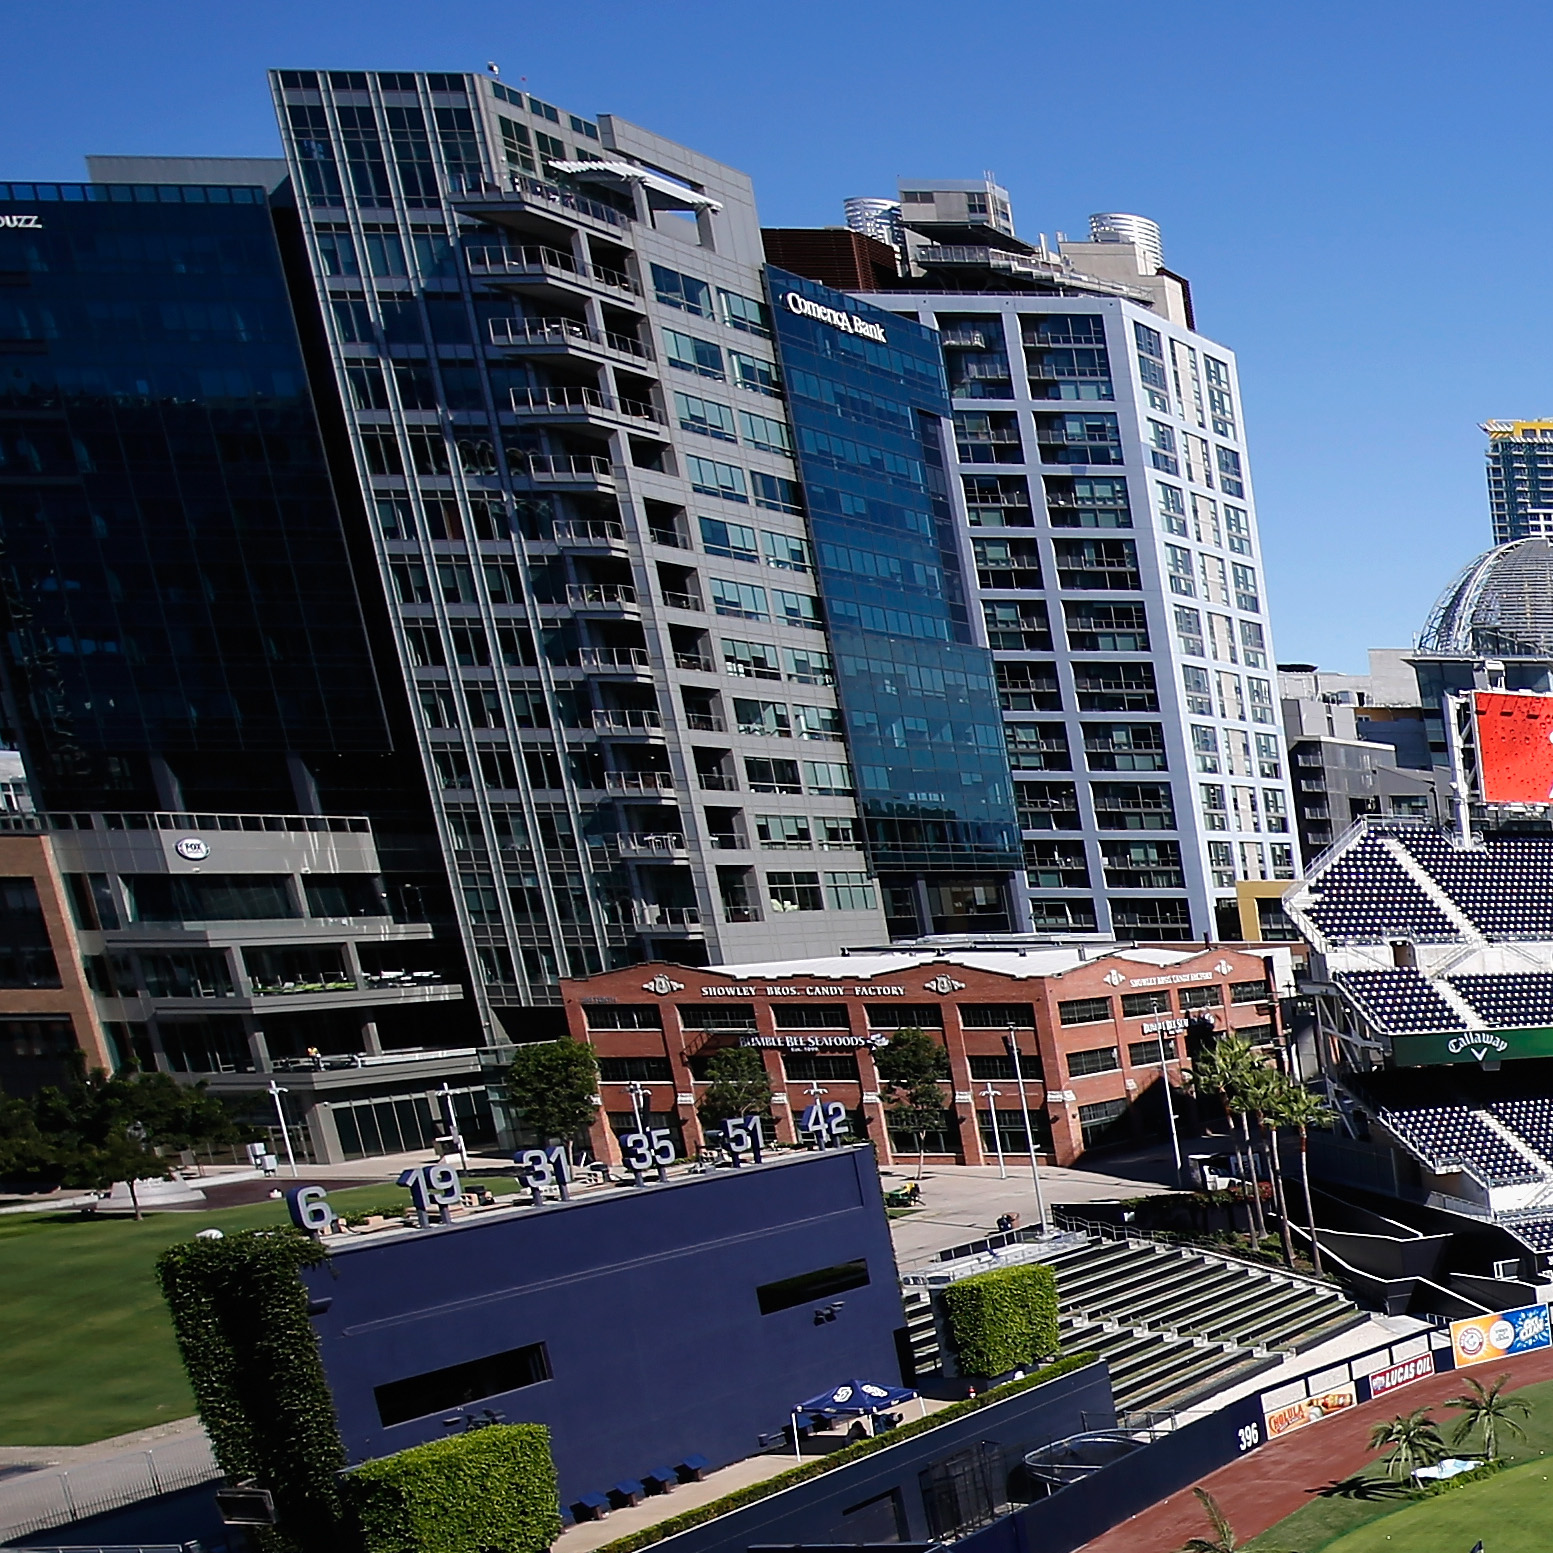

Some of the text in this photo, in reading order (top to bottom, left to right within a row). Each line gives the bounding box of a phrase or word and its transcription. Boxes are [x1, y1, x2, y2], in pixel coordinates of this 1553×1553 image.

[851, 315, 887, 343] Bank
[701, 986, 905, 996] SHOWLEY BROS. CANDY FACTORY
[785, 1036, 806, 1047] BEE
[807, 1036, 866, 1047] SEAFOODS
[1448, 1031, 1508, 1053] Callaway
[804, 1101, 850, 1135] 42
[622, 1128, 676, 1170] 35
[722, 1116, 765, 1152] 51
[518, 1146, 571, 1188] 31
[400, 1164, 462, 1209] 19
[290, 1185, 332, 1230] 6
[1385, 1363, 1415, 1388] LUCAS
[1416, 1357, 1431, 1375] OIL
[1269, 1403, 1305, 1434] CHOLULA
[1238, 1423, 1259, 1450] 396
